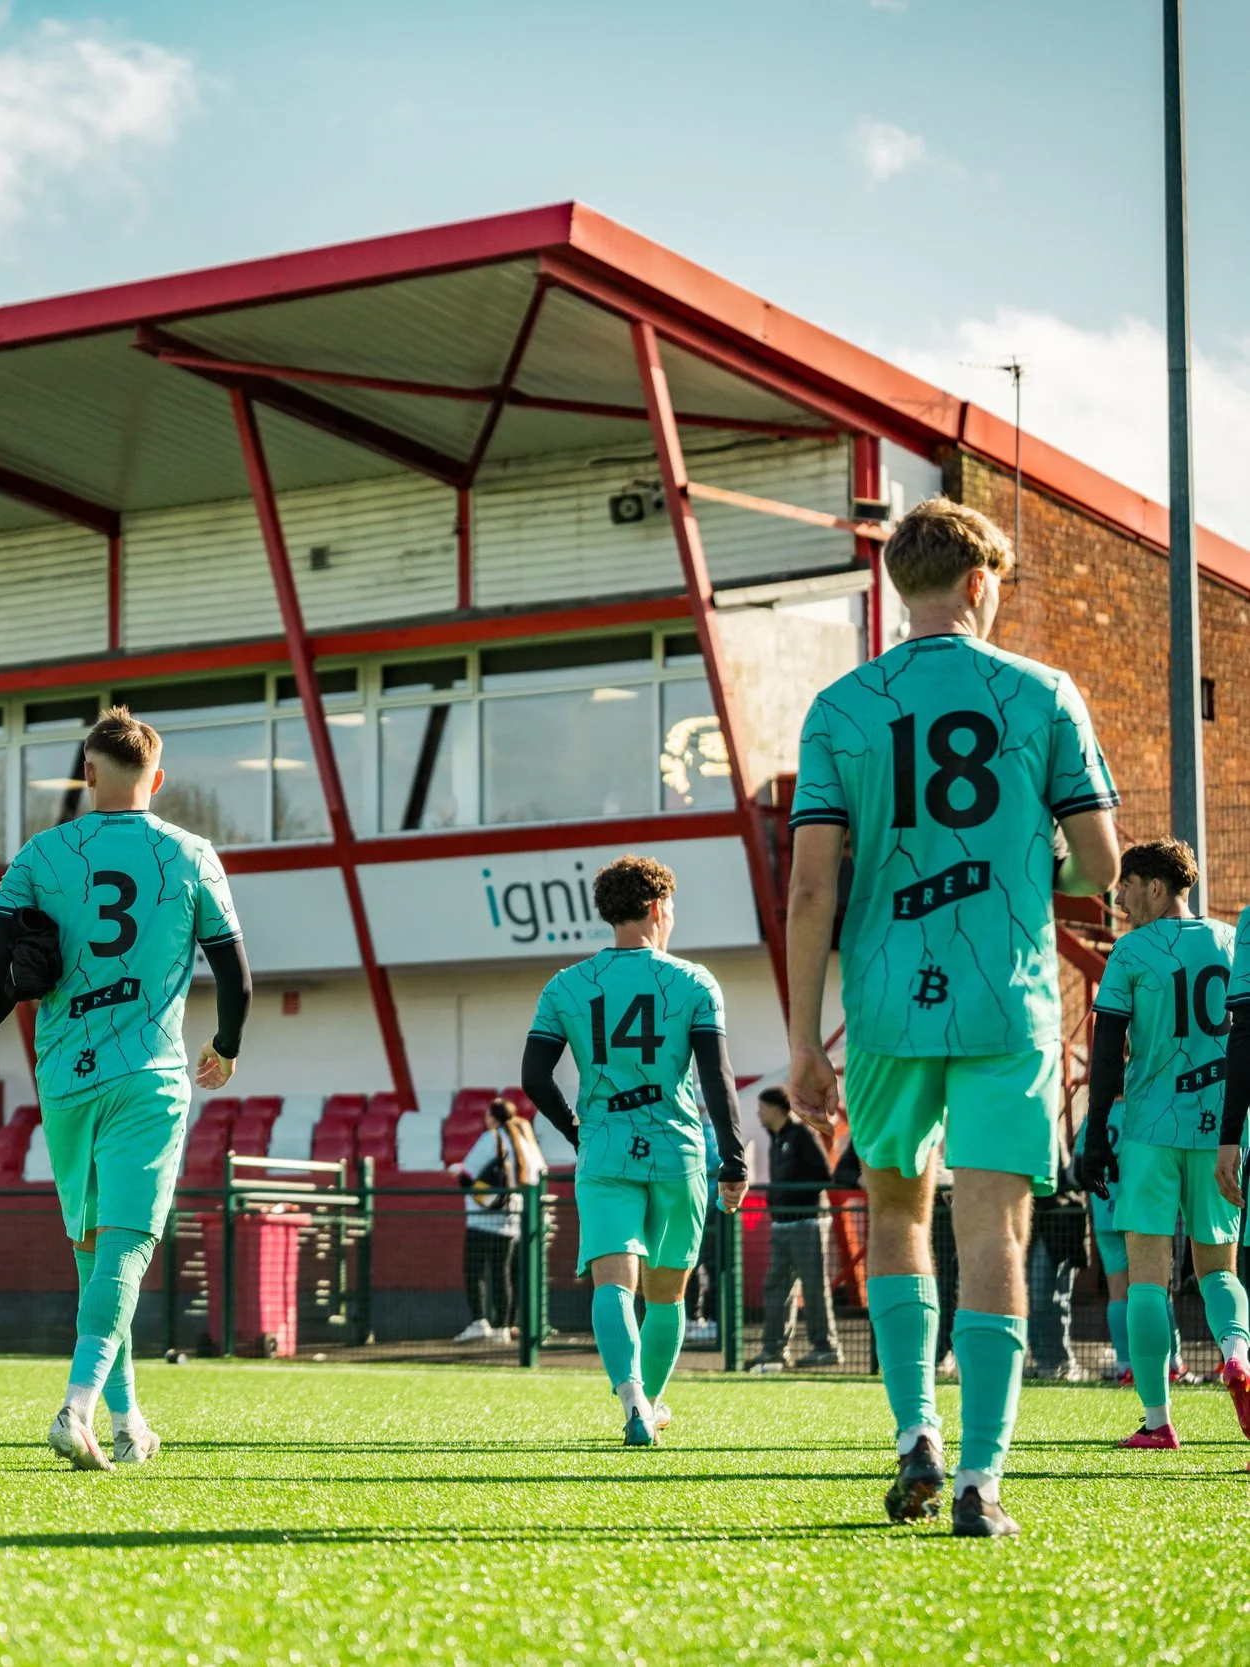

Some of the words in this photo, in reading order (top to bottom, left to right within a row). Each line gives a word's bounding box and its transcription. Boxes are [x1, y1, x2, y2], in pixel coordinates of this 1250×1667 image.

[887, 710, 1000, 829] 18
[88, 870, 138, 958] 3
[481, 861, 592, 944] igni
[900, 866, 980, 915] IREN
[589, 994, 667, 1065] 14
[1171, 964, 1231, 1038] 10
[1181, 1065, 1219, 1090] IRE
